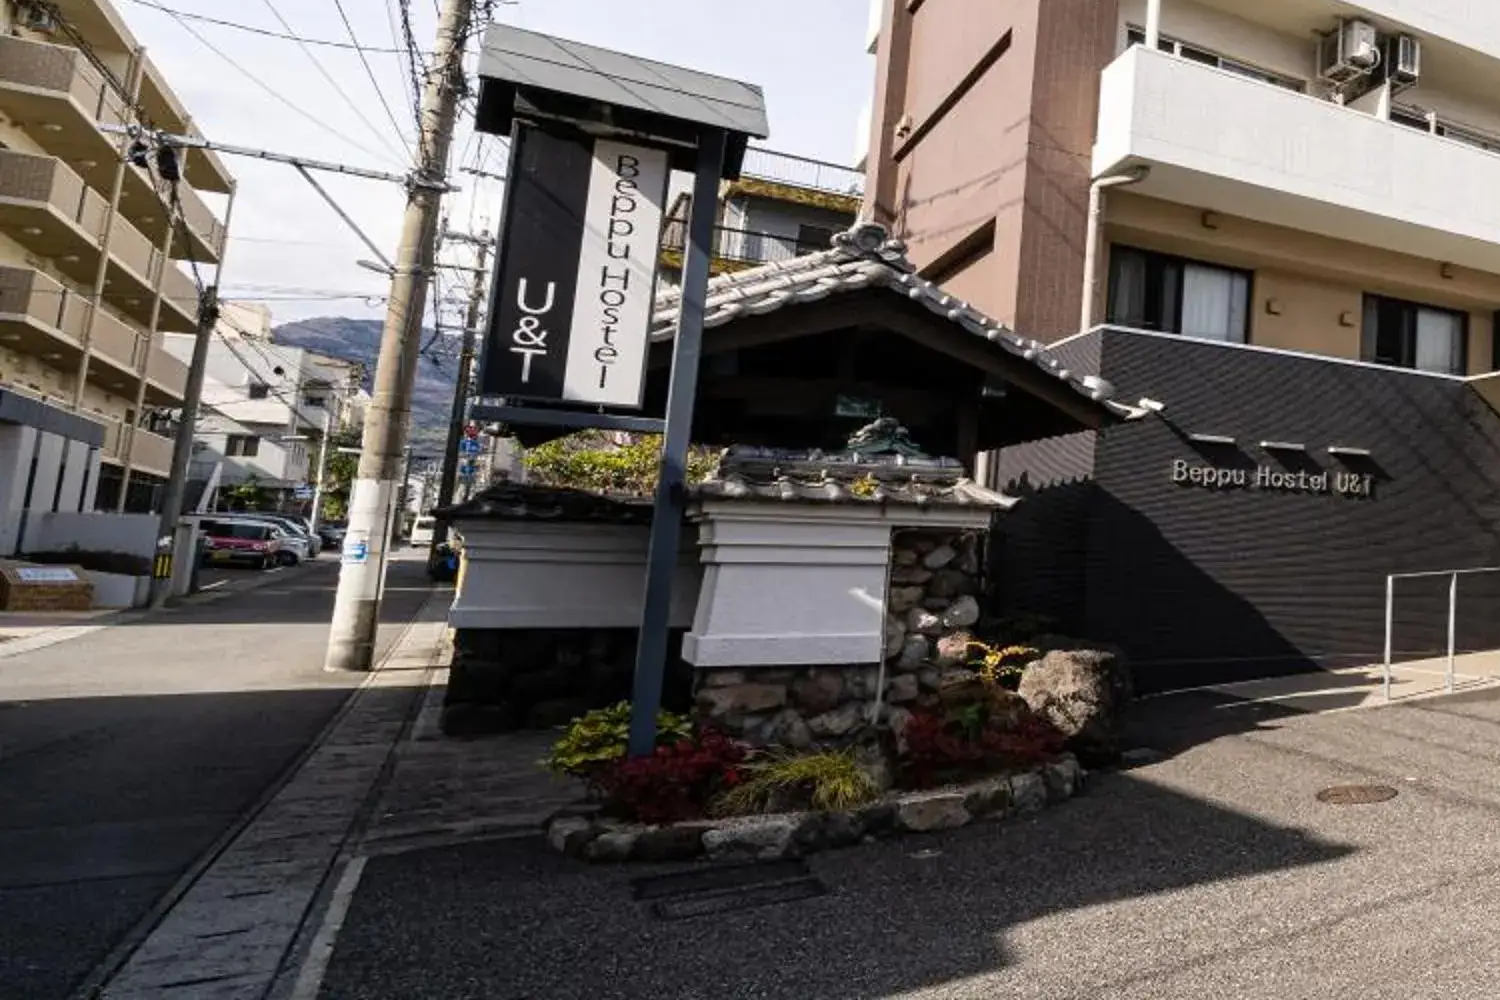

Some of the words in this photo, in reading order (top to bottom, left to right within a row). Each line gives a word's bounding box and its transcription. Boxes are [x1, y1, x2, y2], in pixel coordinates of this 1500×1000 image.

[607, 154, 640, 259] Beppu
[509, 277, 556, 383] U&T
[593, 265, 630, 389] Hostel
[1172, 458, 1245, 487] Beppu
[1256, 465, 1328, 490] Hostel
[1336, 471, 1374, 495] U&T
